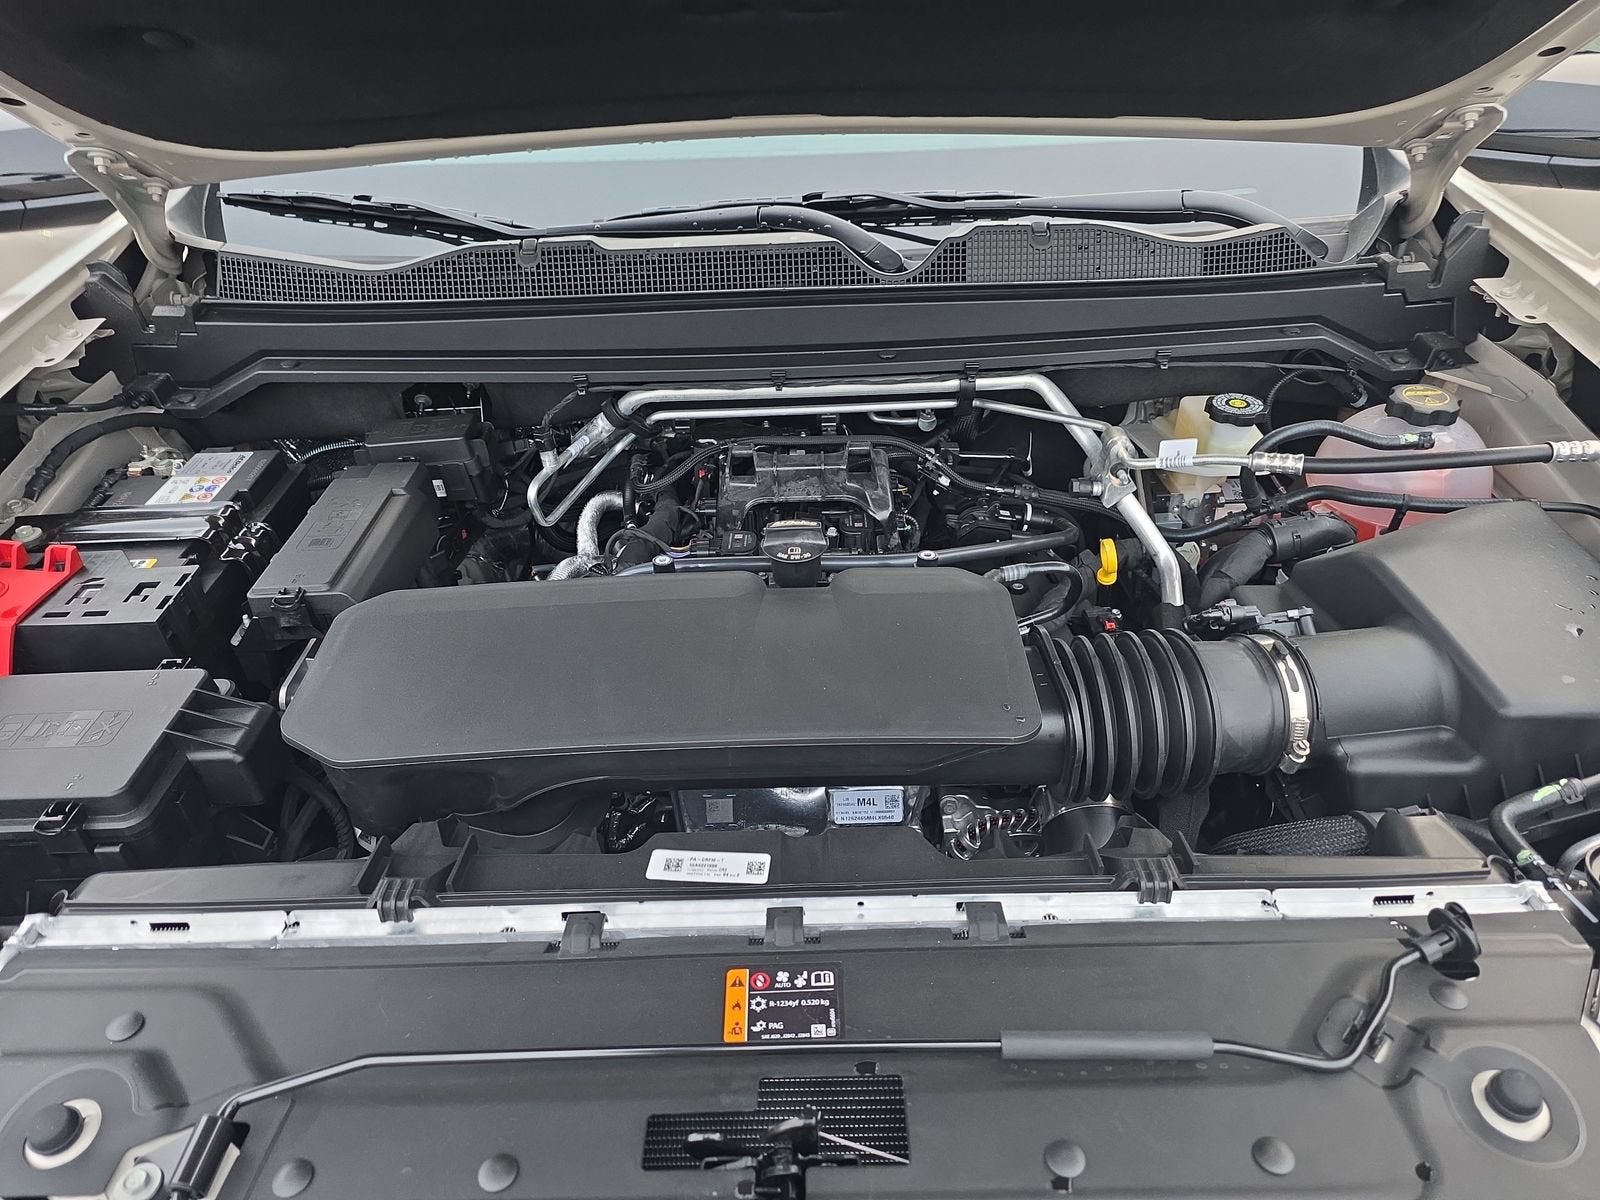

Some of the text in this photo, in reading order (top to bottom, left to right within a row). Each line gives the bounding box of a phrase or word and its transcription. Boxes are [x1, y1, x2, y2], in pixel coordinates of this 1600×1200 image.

[857, 797, 878, 807] M4L
[769, 1000, 799, 1008] R-1234yf
[820, 998, 830, 1007] kg
[768, 1022, 784, 1030] PAG
